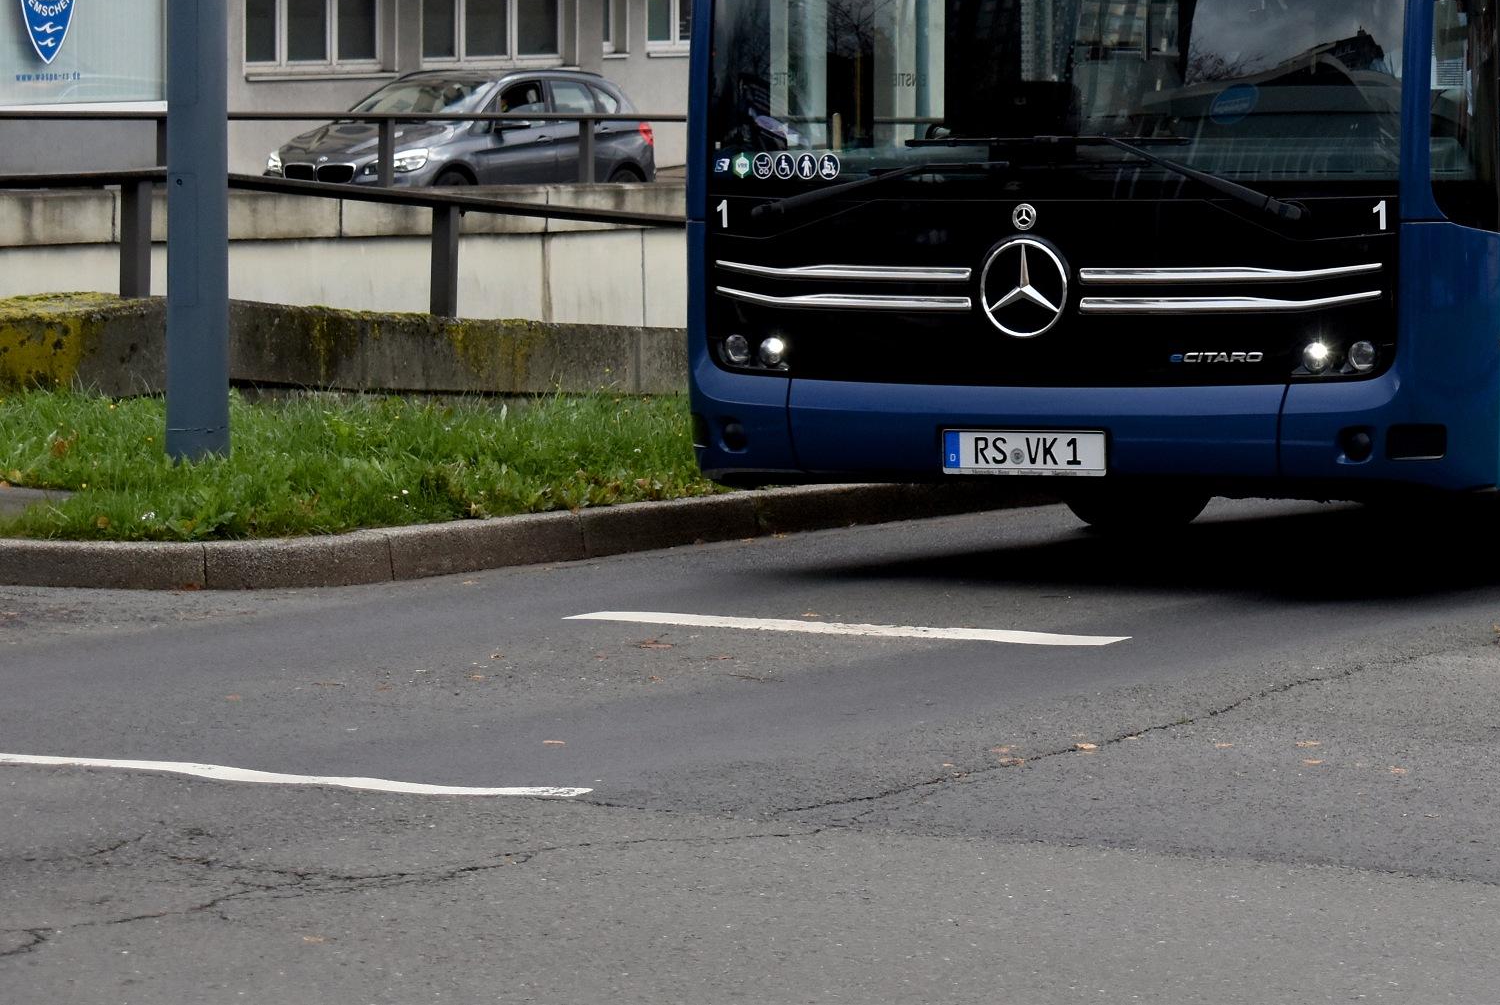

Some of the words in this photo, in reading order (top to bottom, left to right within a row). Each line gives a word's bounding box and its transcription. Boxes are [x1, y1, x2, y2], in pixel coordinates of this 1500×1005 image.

[716, 199, 728, 228] 1
[1372, 200, 1386, 230] 1
[1169, 352, 1264, 363] eCITARO
[974, 437, 1008, 464] RS
[1025, 437, 1058, 465] VK
[1066, 438, 1082, 465] 1
